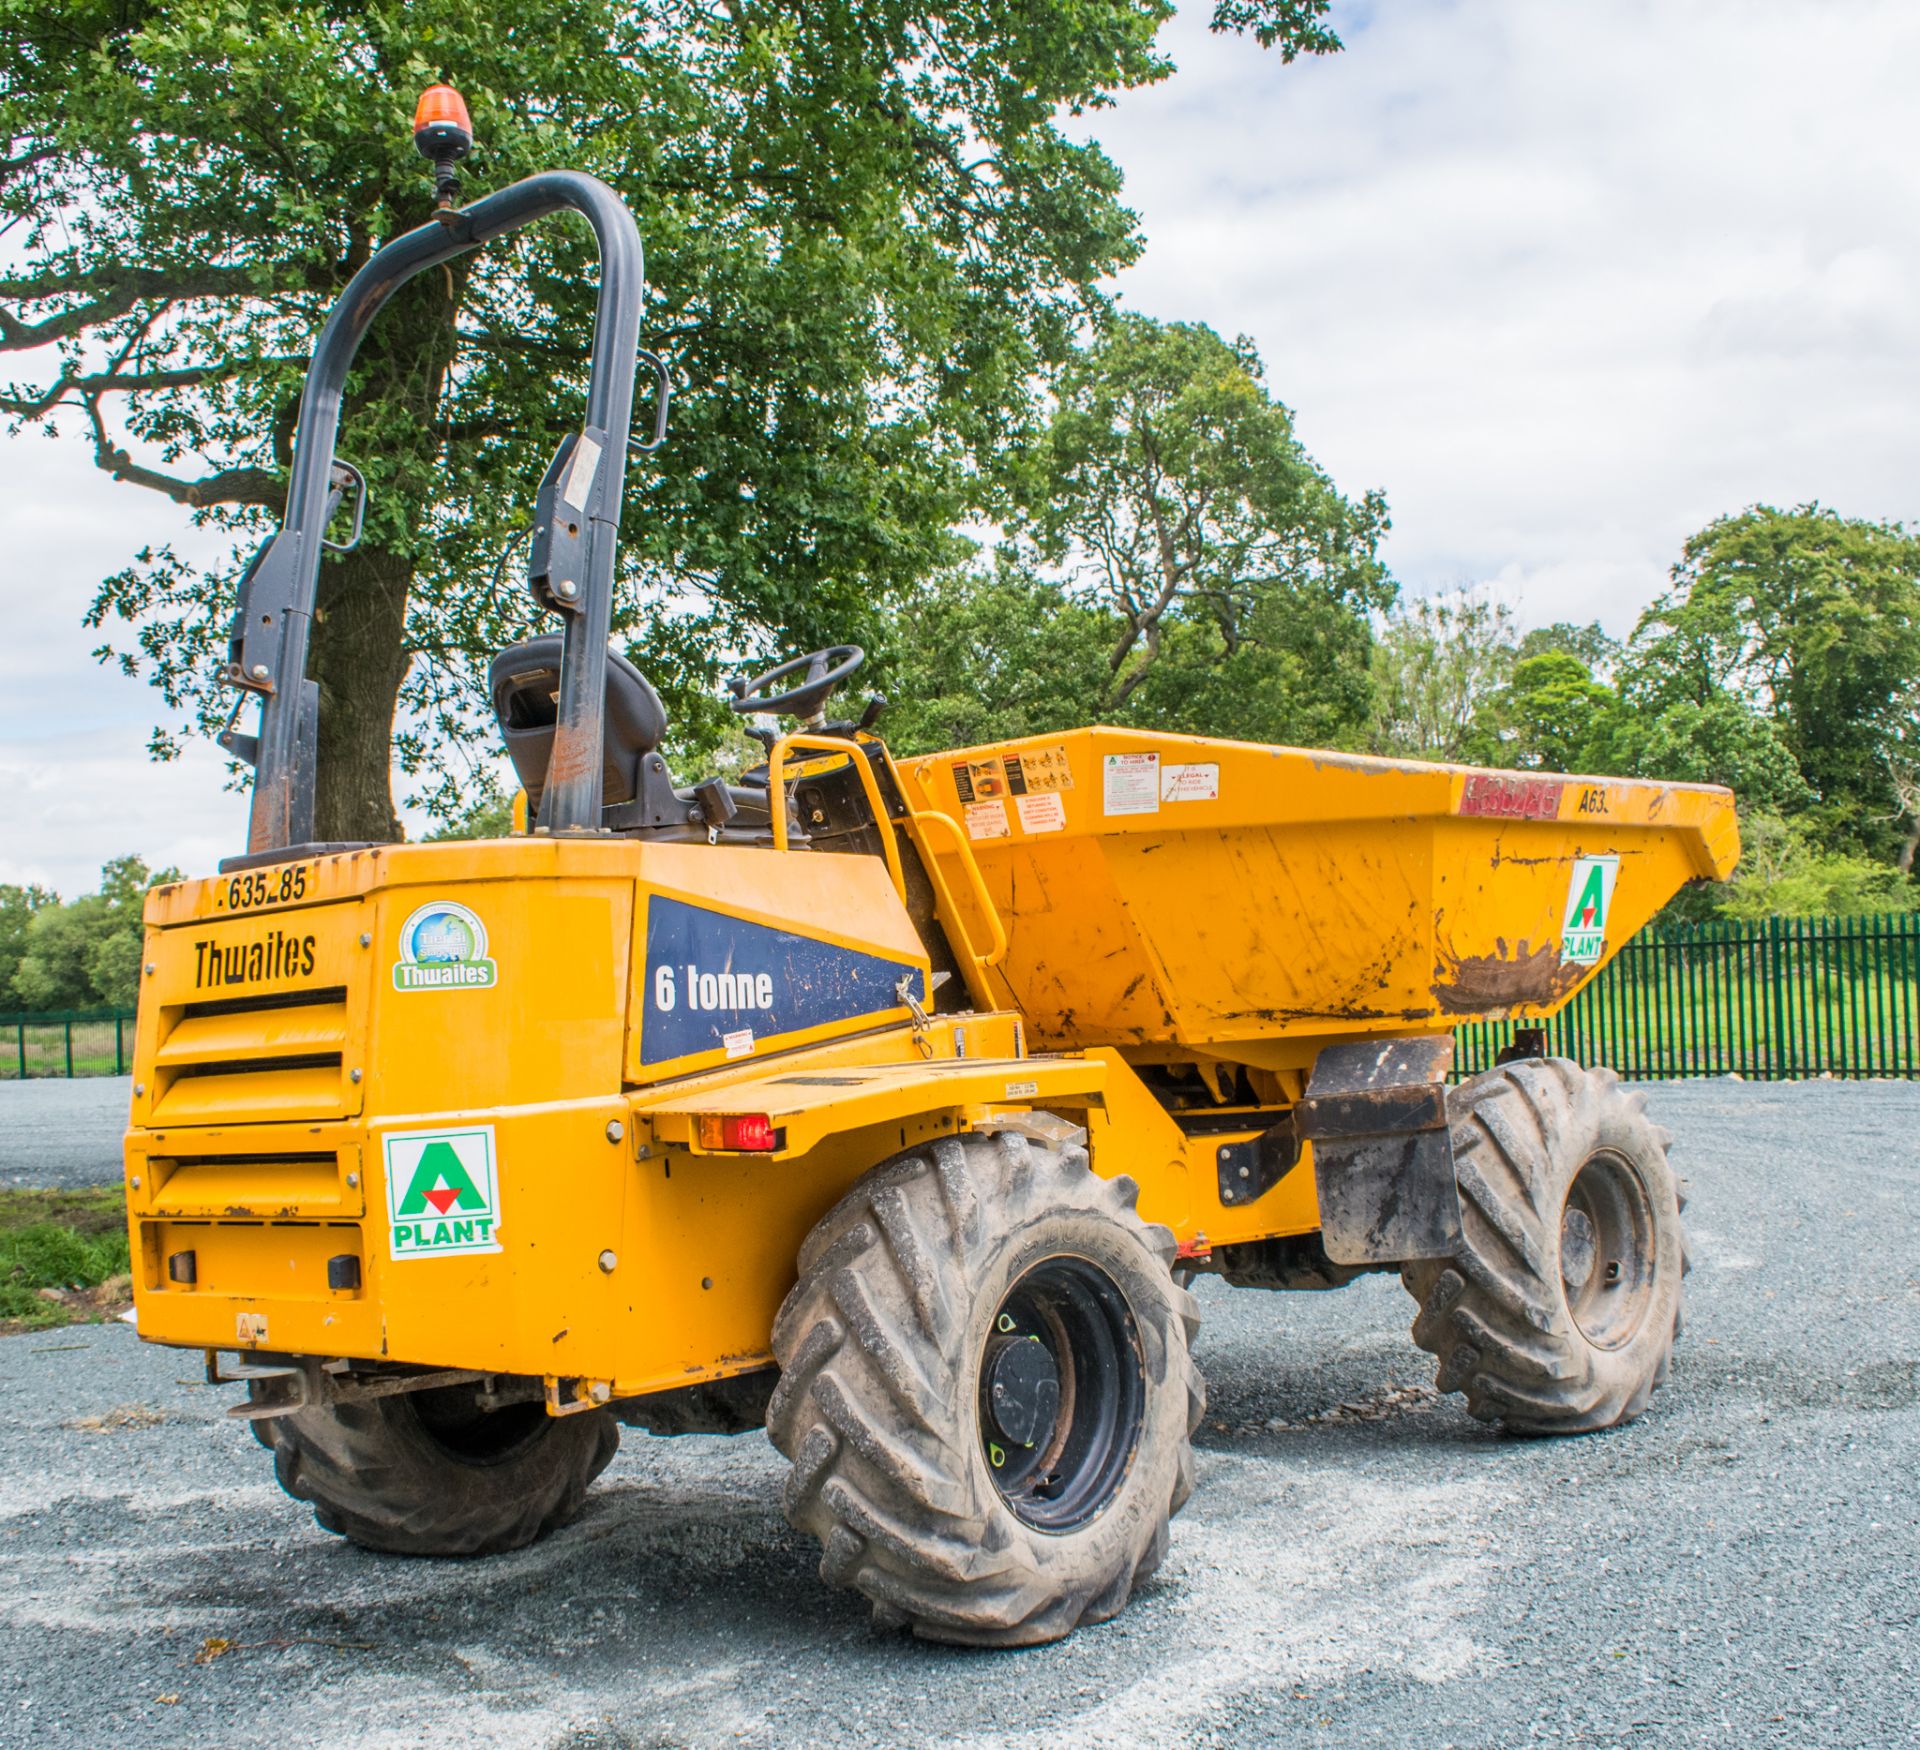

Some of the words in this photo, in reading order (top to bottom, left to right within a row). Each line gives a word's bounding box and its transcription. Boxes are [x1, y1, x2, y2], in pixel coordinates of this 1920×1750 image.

[1569, 865, 1603, 928] A
[195, 929, 316, 989] Thwaites
[401, 963, 489, 986] Thwaites
[655, 965, 676, 1012] 6
[687, 964, 774, 1010] tonne
[396, 1141, 487, 1215] A
[394, 1217, 494, 1249] PLANT
